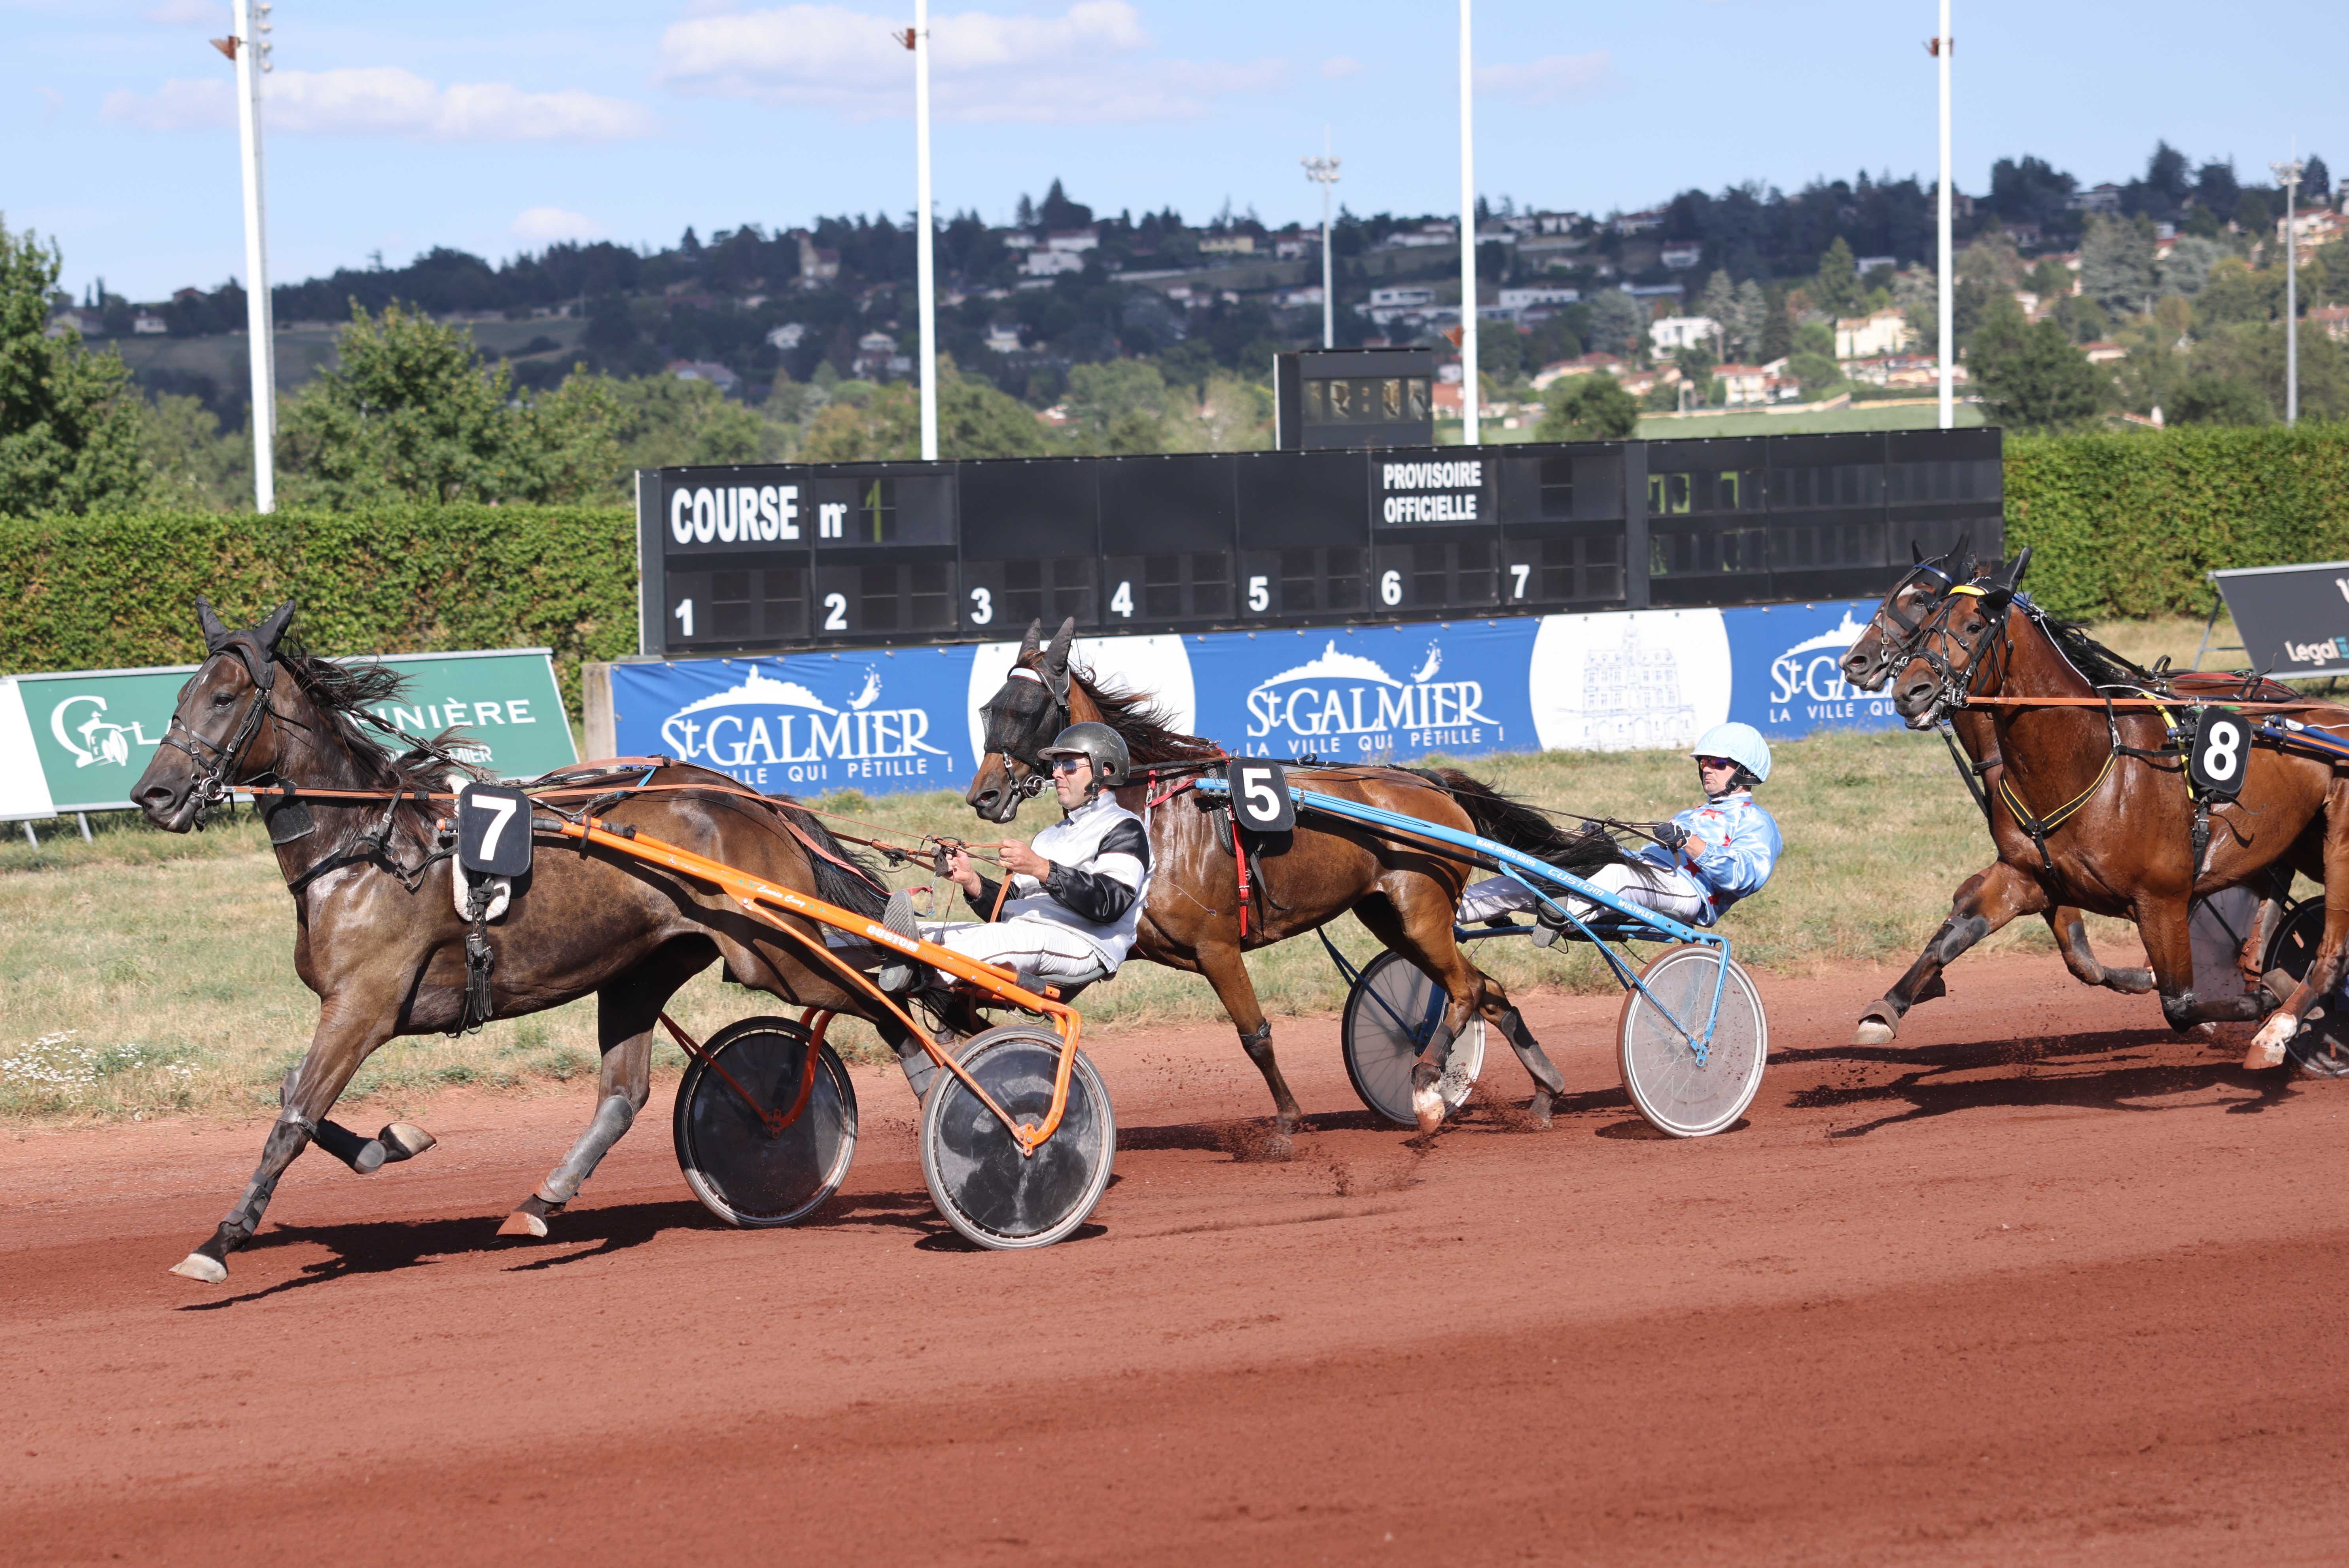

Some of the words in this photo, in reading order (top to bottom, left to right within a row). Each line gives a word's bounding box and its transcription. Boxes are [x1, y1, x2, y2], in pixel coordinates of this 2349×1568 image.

[1383, 461, 1482, 490] PROVISOIRE
[671, 485, 799, 544] COURSE
[1384, 494, 1477, 523] OFFICIELLE
[1248, 576, 1270, 612] 5
[1381, 570, 1402, 606] 6
[1510, 564, 1530, 598] 7
[824, 593, 847, 630] 2
[970, 587, 993, 624] 3
[1111, 581, 1134, 617] 4
[675, 598, 693, 636] 1
[1770, 708, 1791, 723] LA
[1807, 703, 1854, 719] VILLE
[1870, 701, 1895, 716] QU
[1247, 742, 1270, 757] LA
[1287, 737, 1340, 754] VILLE
[1358, 734, 1393, 751] QUI
[1499, 726, 1503, 741] !
[2203, 721, 2240, 781] 8
[788, 764, 827, 782] QUI
[948, 757, 953, 772] !
[1242, 768, 1280, 822] 5
[472, 794, 516, 861] 7
[1476, 839, 1495, 850] BLANC
[1495, 846, 1516, 858] SPORTS
[1516, 855, 1537, 867] SULKYS
[1547, 869, 1605, 897] CUSTOM
[1618, 899, 1655, 920] MULTIFLEX
[866, 925, 919, 953] CUSTOM
